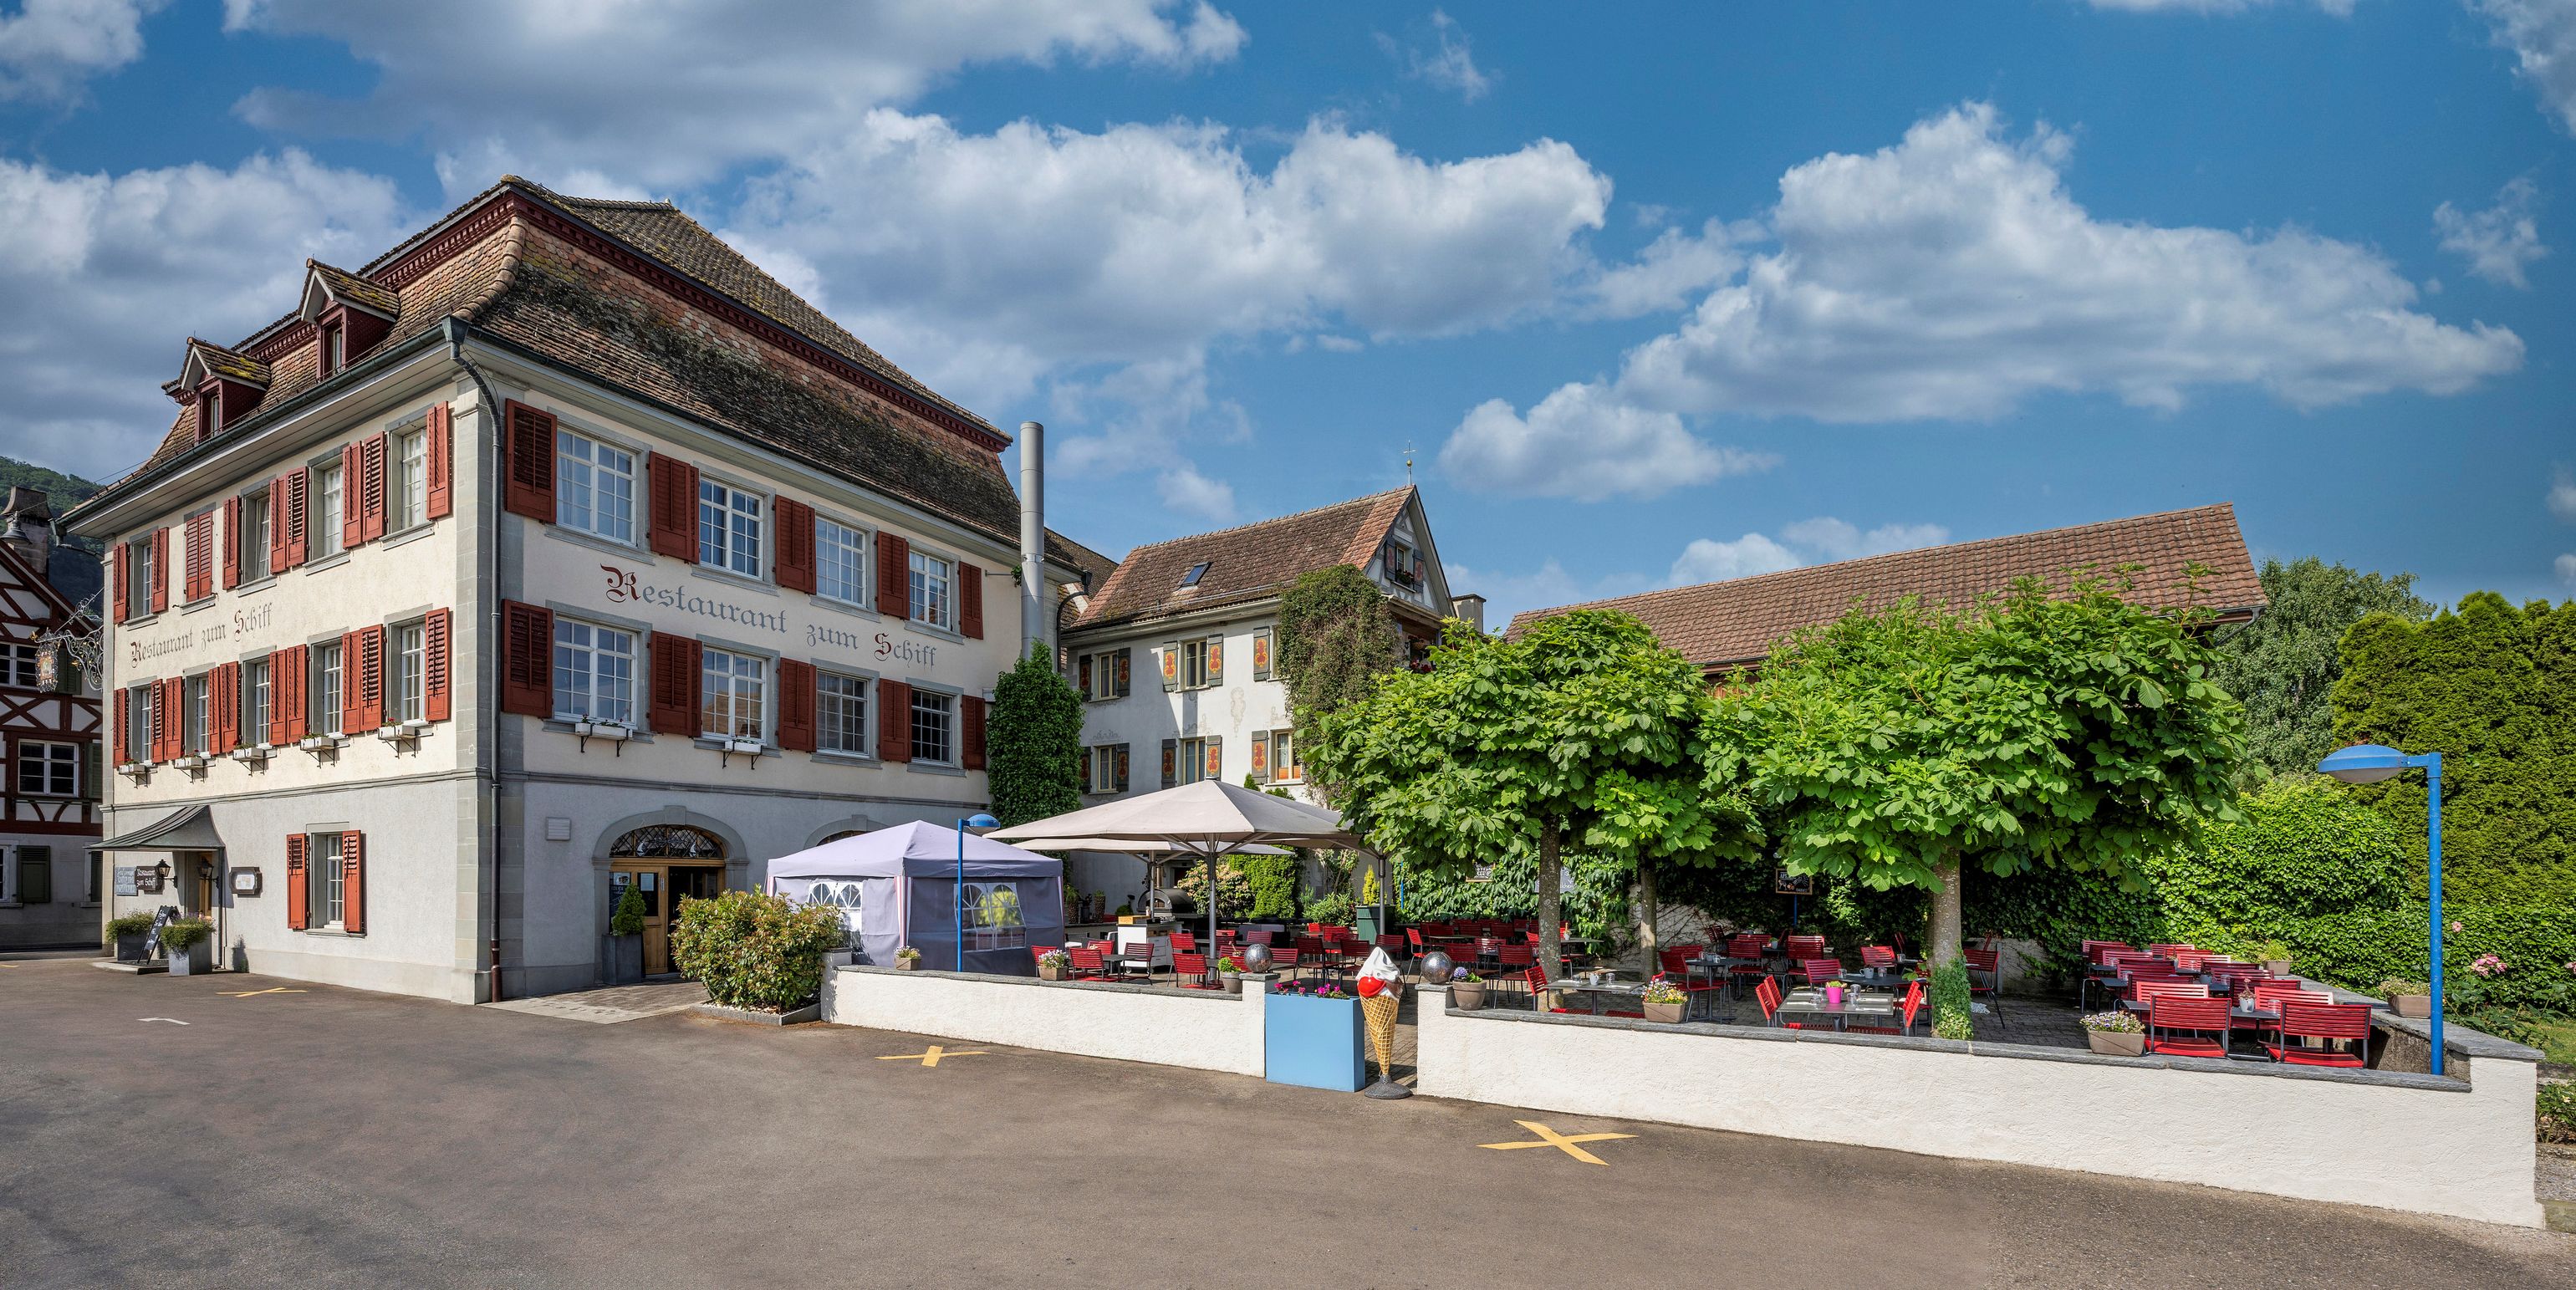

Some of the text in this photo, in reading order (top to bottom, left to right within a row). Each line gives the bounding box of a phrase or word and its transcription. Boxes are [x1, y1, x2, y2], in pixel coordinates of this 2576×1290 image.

[130, 602, 273, 668] Restaurant zum Schiff
[599, 563, 937, 670] Restaurant zum Schiff
